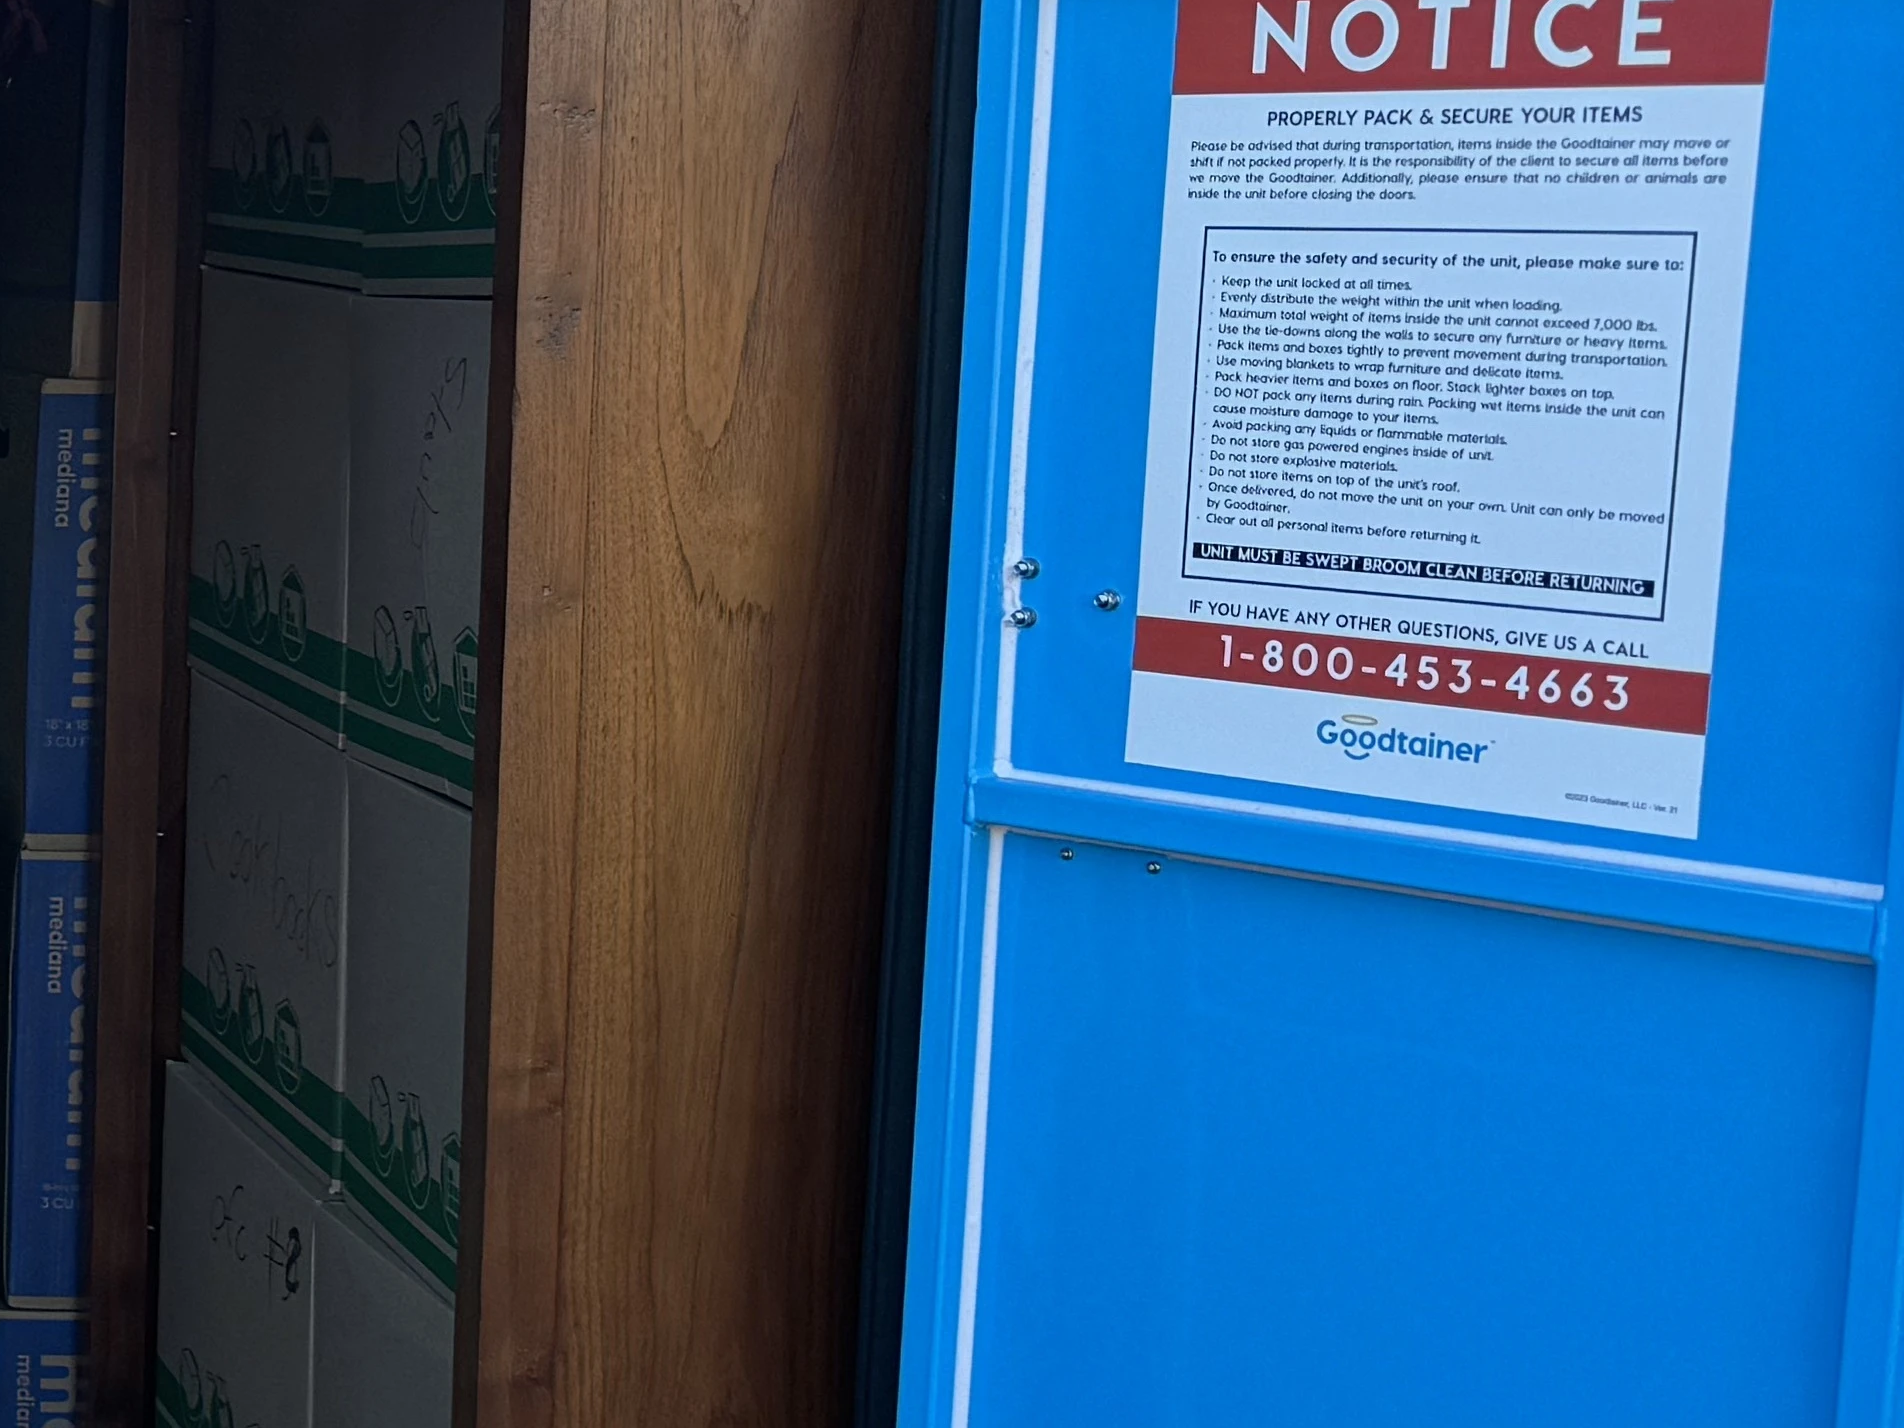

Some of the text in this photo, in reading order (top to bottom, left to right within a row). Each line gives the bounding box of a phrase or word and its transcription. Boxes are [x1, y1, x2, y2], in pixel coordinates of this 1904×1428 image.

[1267, 106, 1643, 127] PROPERLY PACK & SECURE YOUR ITEMS
[1213, 251, 1684, 271] To ensure the safety and security of the unit, please make sure to:
[1221, 275, 1412, 291] Keep the unit locked at all times.
[1219, 307, 1657, 332] Maximum total weight of items inside the unit cannot exceed 7,000 lbs.
[54, 428, 76, 528] mediana
[1201, 544, 1644, 594] UNIT MUST BE SWEPT BROOM CLEAN BEFORE RETURNING
[1190, 599, 1649, 658] IF YOU HAVE ANY OTHER QUESTIONS, GIVE US A CALL
[1220, 634, 1629, 711] 1-800-453-4663
[1316, 720, 1488, 763] Goodtainer
[48, 896, 68, 994] mediana
